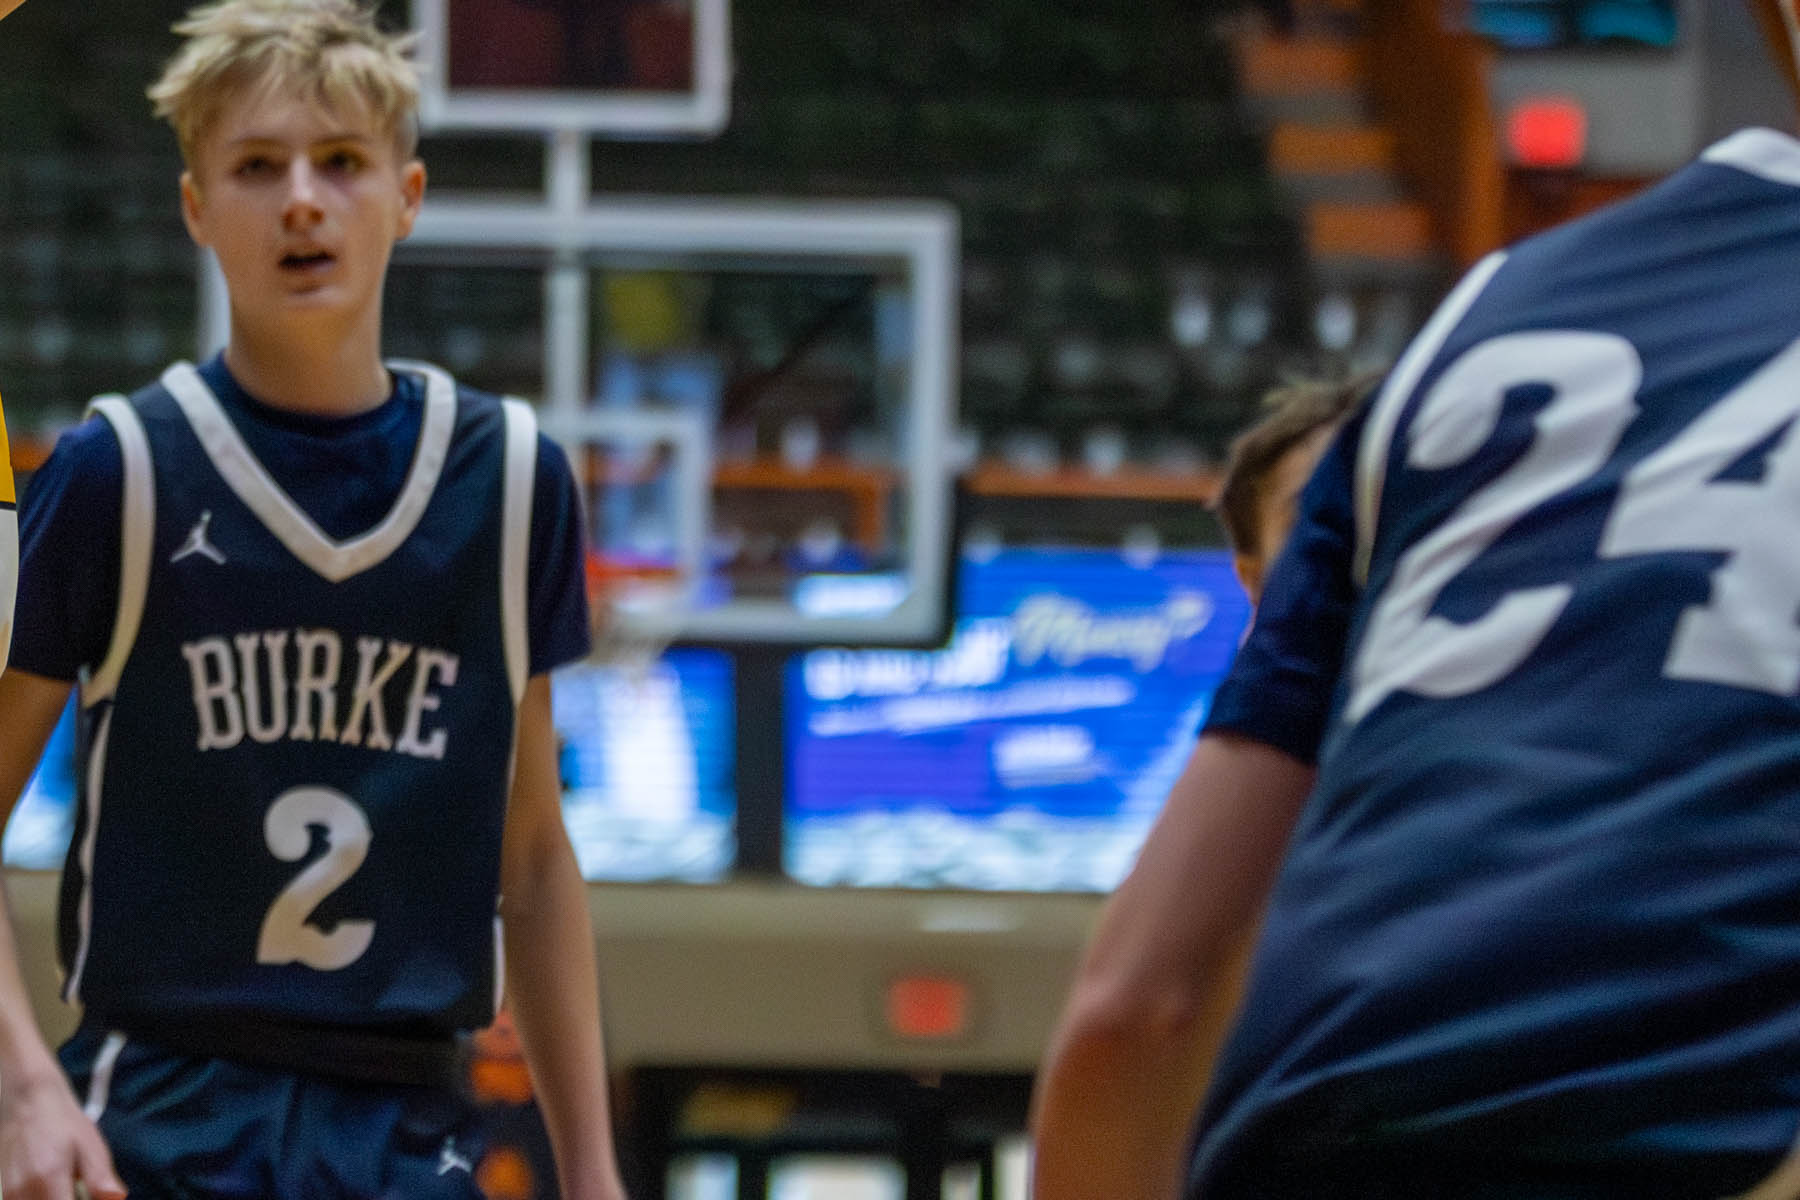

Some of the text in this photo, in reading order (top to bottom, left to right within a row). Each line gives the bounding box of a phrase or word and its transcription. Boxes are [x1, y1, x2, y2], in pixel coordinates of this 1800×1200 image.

[1343, 330, 1800, 723] 24
[182, 629, 458, 760] BURKE
[257, 784, 375, 971] 2
